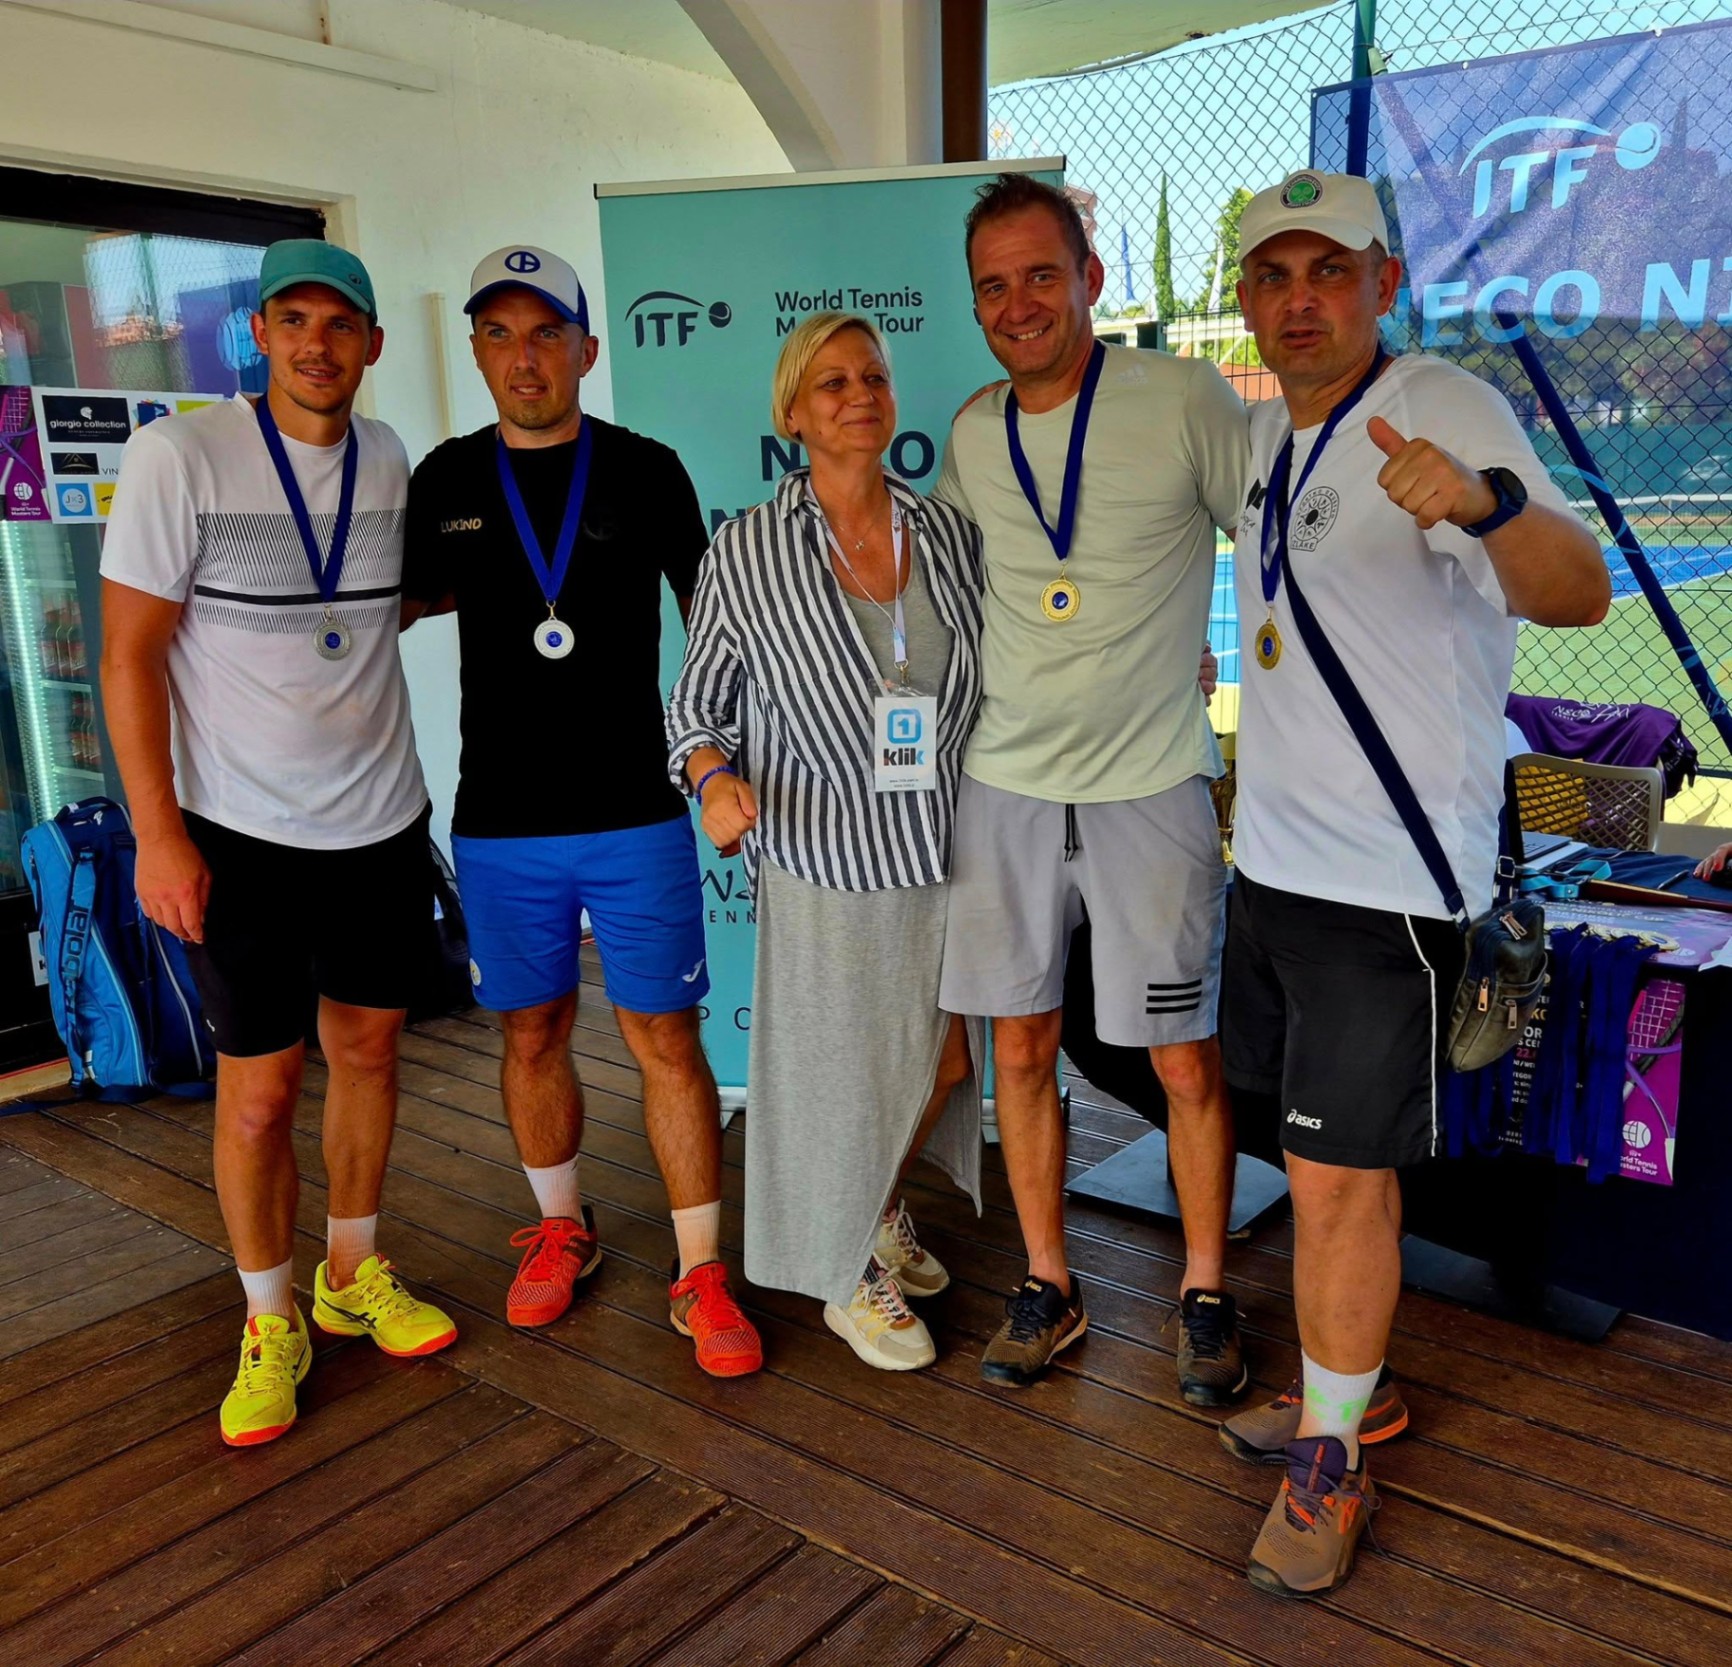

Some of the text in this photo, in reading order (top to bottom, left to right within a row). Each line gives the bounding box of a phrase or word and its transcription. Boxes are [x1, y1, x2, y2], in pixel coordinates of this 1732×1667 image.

[1473, 145, 1597, 219] ITF
[775, 286, 923, 312] World Tennis
[634, 310, 699, 348] ITF
[874, 312, 924, 334] Tour
[50, 419, 126, 429] giorgio collection
[883, 747, 925, 766] klik
[1295, 1113, 1322, 1130] asics
[1620, 1155, 1658, 1170] orld Tennis
[1641, 1165, 1658, 1176] Tour
